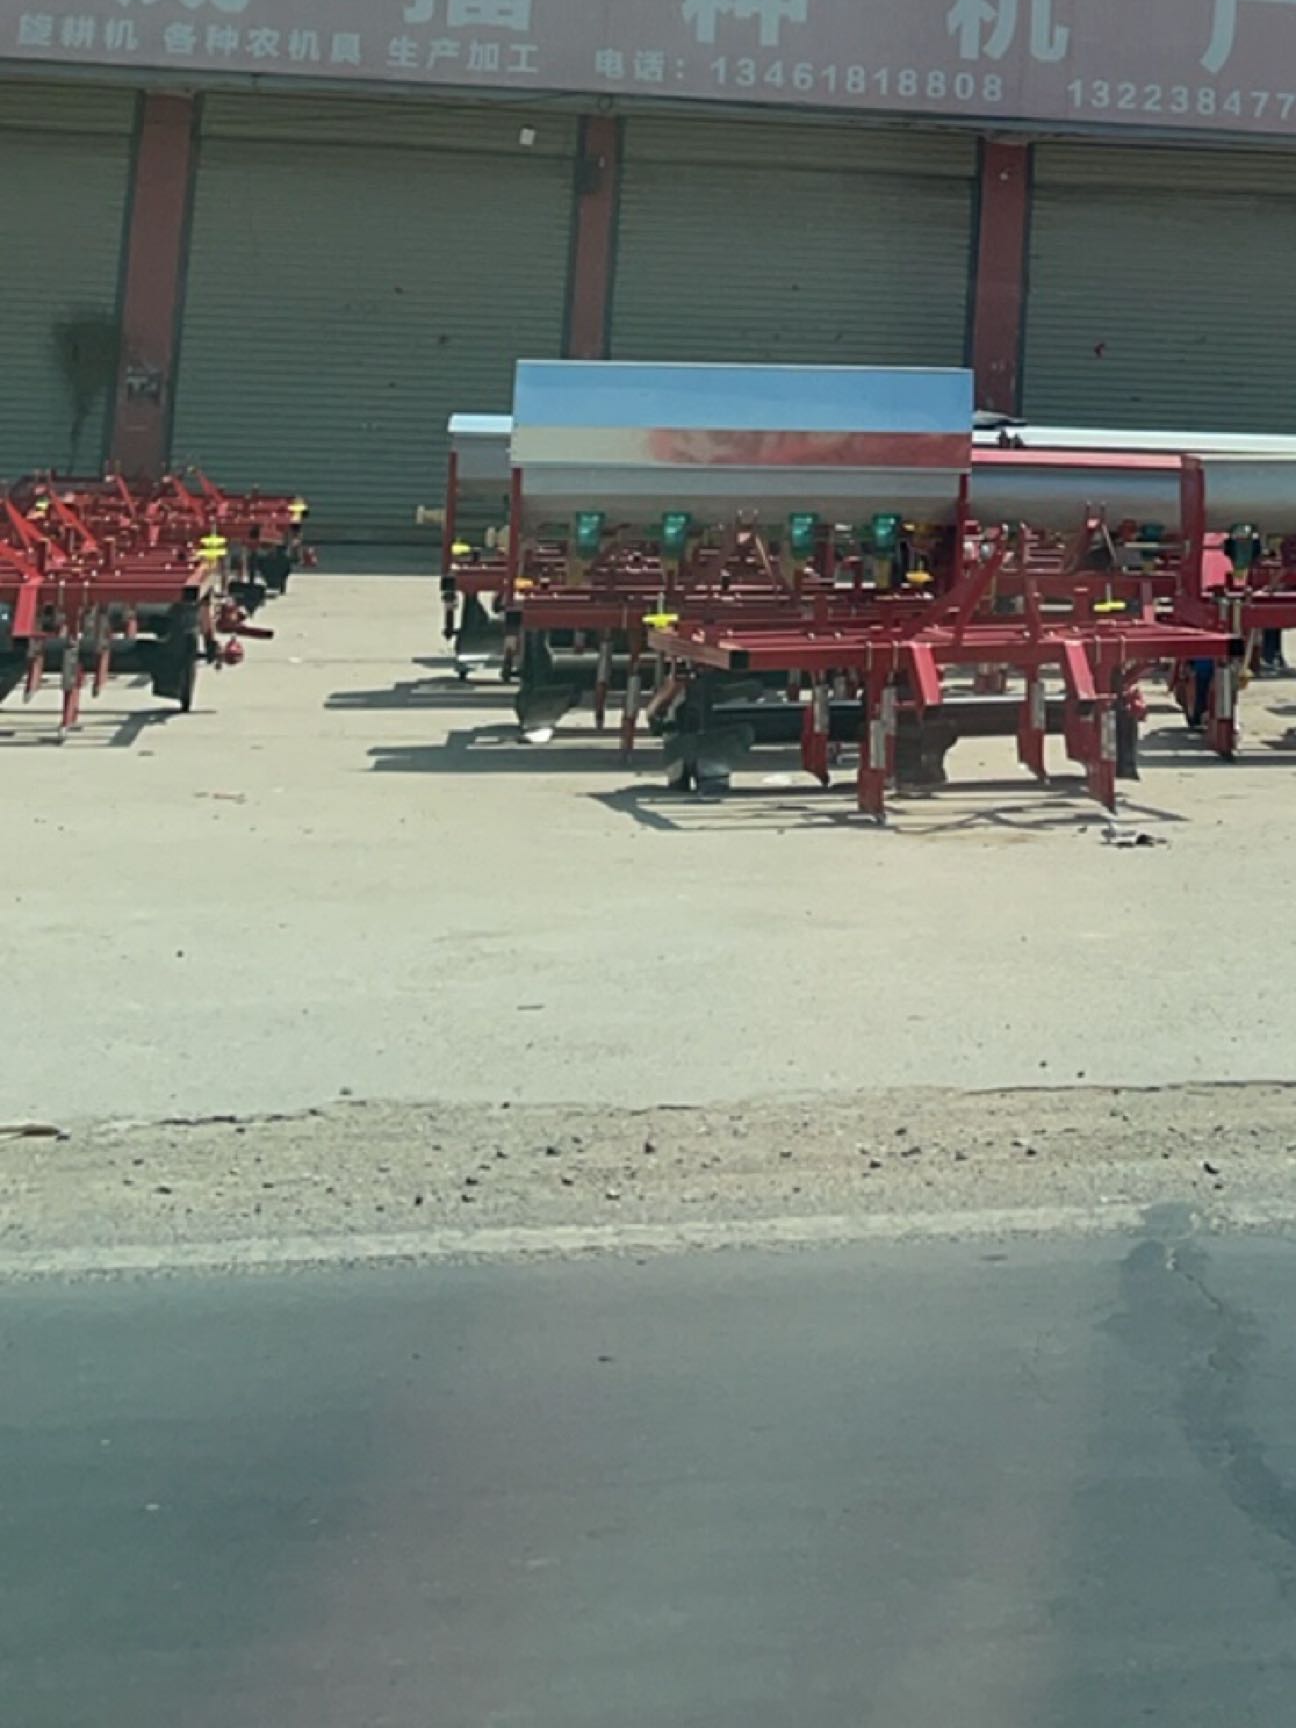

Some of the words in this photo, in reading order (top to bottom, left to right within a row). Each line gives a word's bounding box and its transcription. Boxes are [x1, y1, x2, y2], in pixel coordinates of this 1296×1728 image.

[162, 22, 362, 65] 各种农机具
[387, 37, 541, 74] 生产加工
